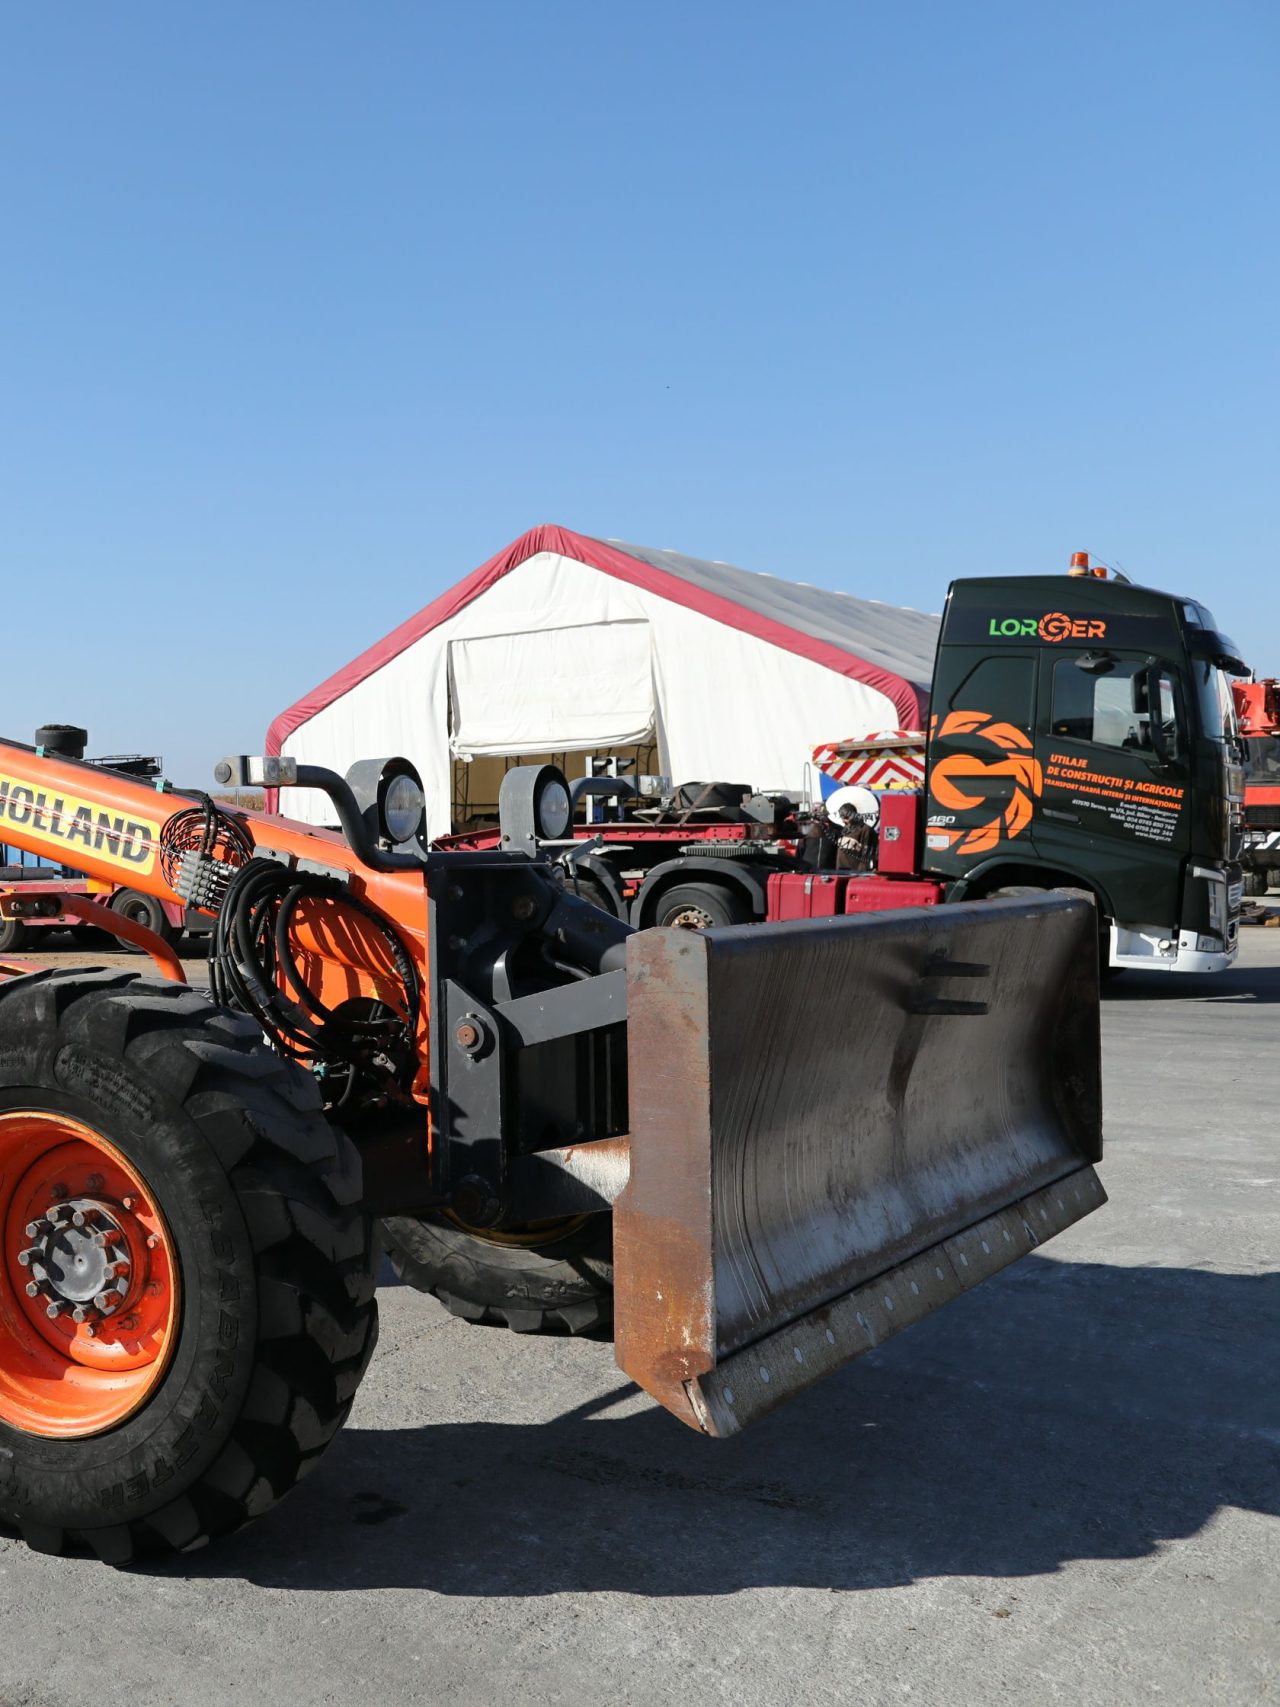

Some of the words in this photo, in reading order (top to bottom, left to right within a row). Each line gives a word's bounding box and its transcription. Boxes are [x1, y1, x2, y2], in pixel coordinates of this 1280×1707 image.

[989, 612, 1107, 642] LORGER
[1050, 753, 1088, 769] UTILAJE
[1043, 778, 1080, 790] TRANSPORT
[1101, 789, 1124, 799] INTERN
[1046, 765, 1060, 776] DE
[1135, 782, 1184, 799] AGRICOLE
